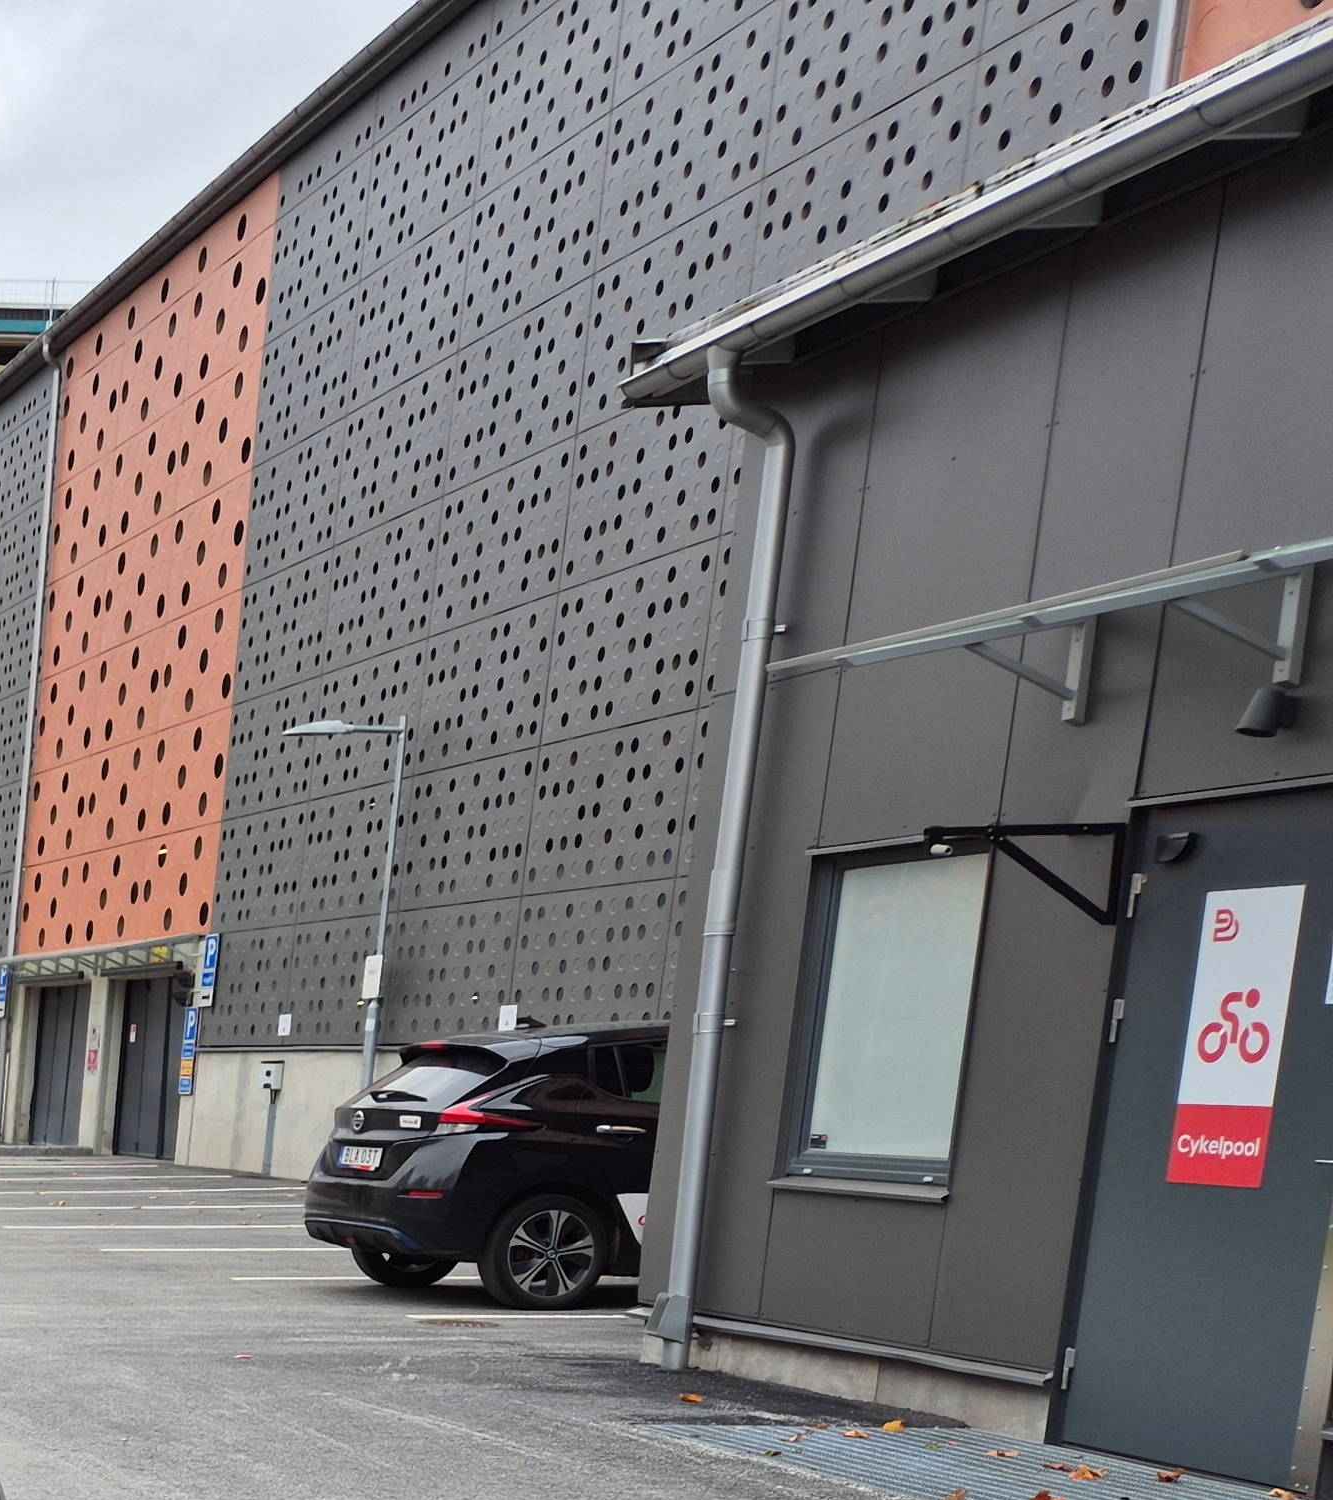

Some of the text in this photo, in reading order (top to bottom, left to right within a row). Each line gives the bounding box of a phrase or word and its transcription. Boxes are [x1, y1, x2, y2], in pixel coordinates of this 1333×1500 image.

[206, 938, 216, 966] P
[186, 1010, 195, 1038] P
[344, 1148, 360, 1163] BLA
[1177, 1134, 1260, 1158] Cykelpool
